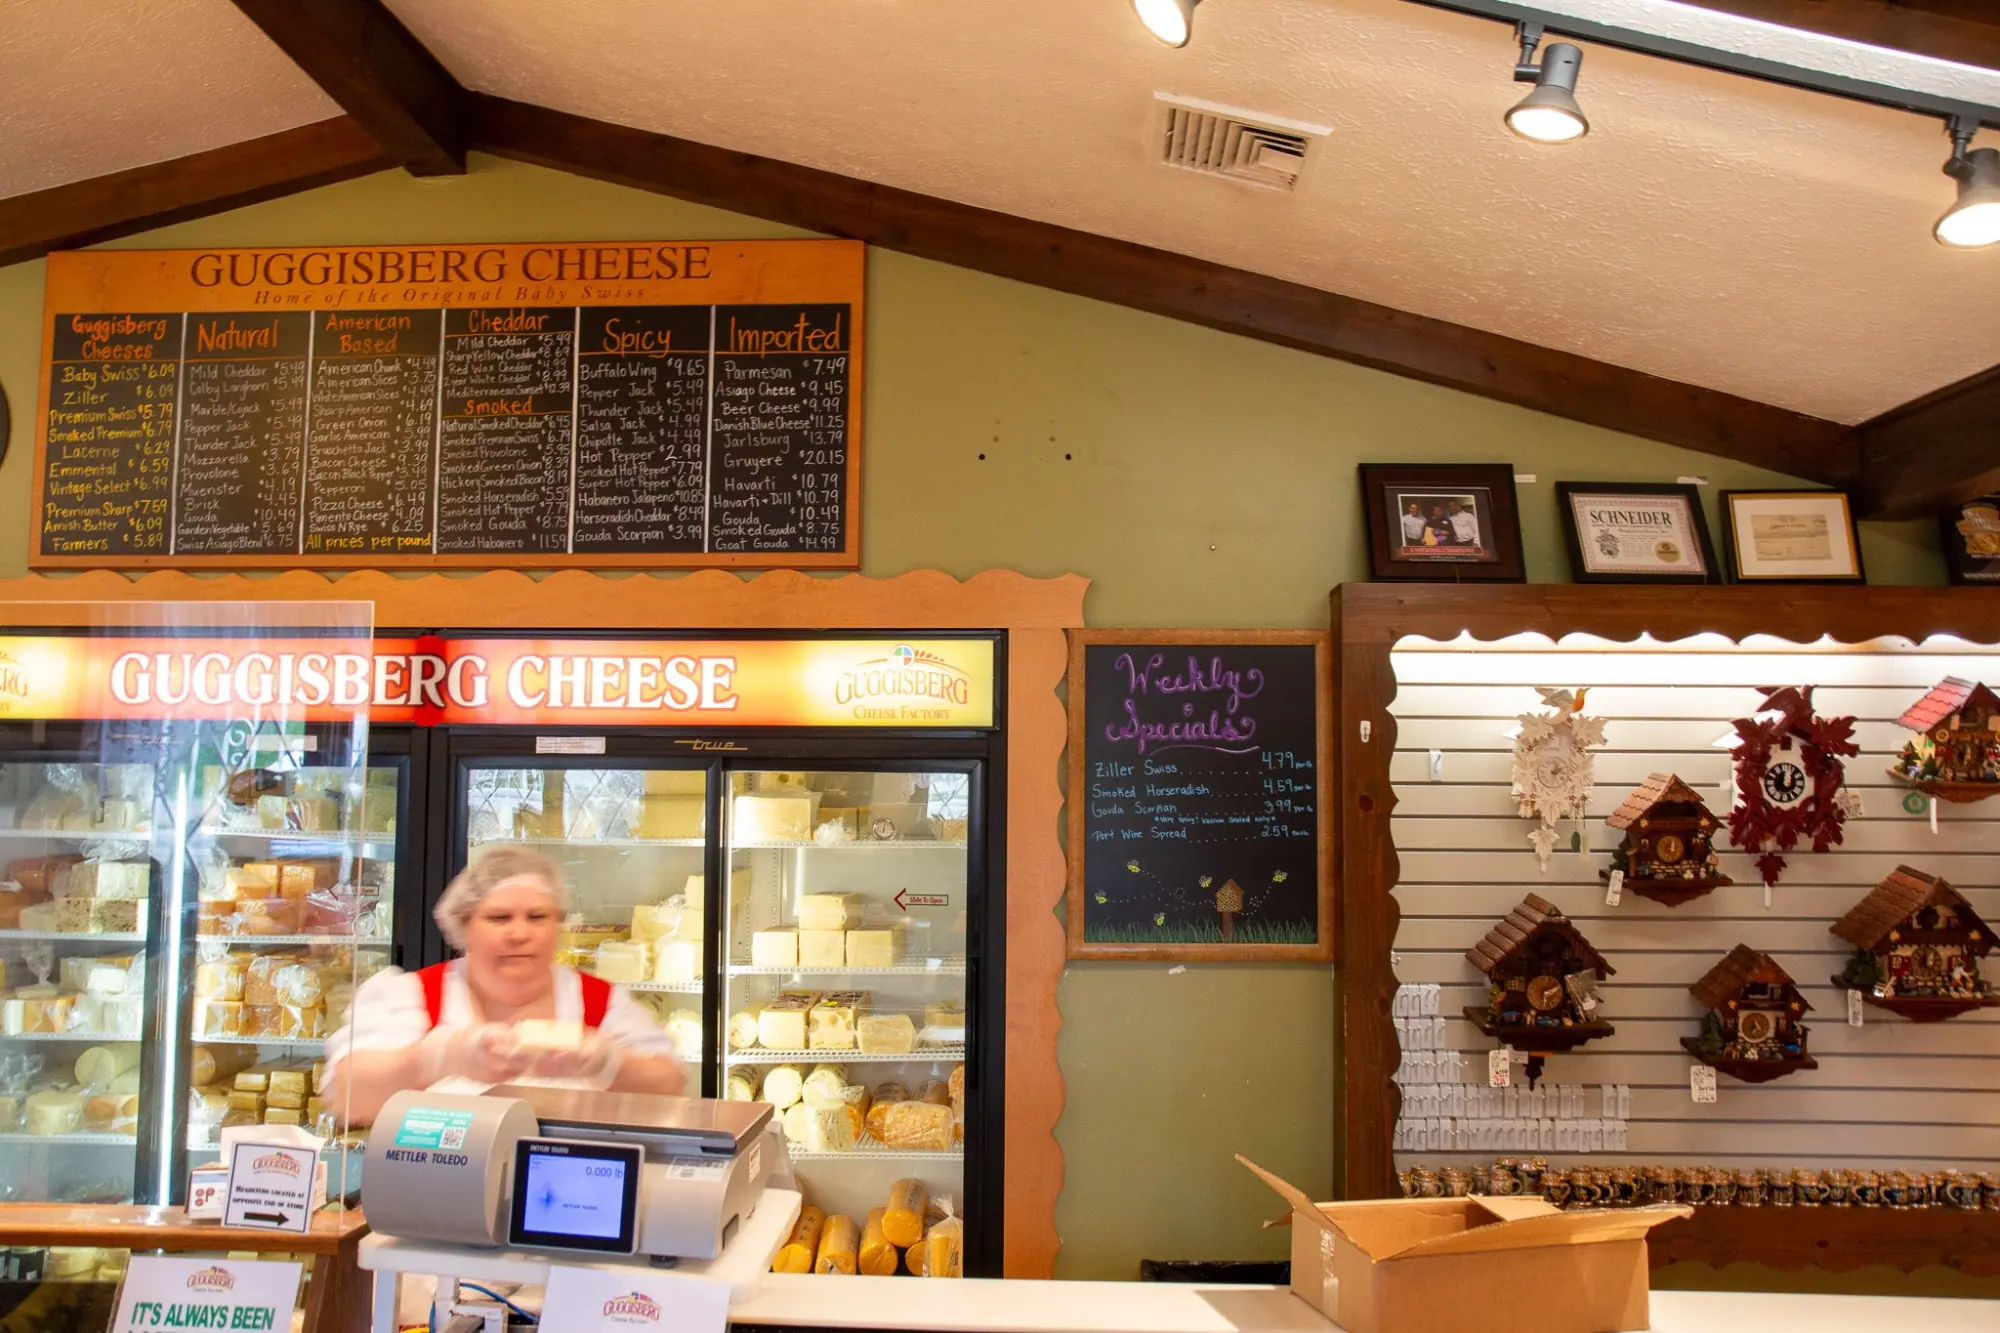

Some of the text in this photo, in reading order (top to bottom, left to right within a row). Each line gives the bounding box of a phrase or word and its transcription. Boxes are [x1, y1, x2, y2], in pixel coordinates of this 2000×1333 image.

[190, 246, 712, 288] GUGGISBERG CHEESE
[254, 285, 646, 309] Home of the Original Baby Swiss
[71, 314, 167, 342] Guggisberg
[325, 312, 411, 332] American
[468, 308, 550, 332] Cheddar
[198, 319, 279, 353] Natural
[339, 332, 398, 353] Based
[456, 335, 531, 350] Mild Cheddar
[603, 317, 671, 358] Spicy
[730, 312, 841, 358] Imported
[82, 340, 154, 359] Cheeses
[61, 364, 140, 390] Baby Swiss
[190, 364, 268, 379] Mild Cheddar
[579, 363, 627, 380] Buffalo
[627, 361, 657, 383] Wing
[724, 360, 792, 379] Parmesan
[62, 391, 108, 405] Ziller
[579, 384, 620, 401] Pepper
[628, 381, 656, 397] Jack
[715, 382, 755, 403] Asiago
[758, 381, 797, 396] Cheese
[464, 395, 533, 415] Smoked
[579, 403, 632, 417] Thunder
[638, 401, 664, 415] Jack
[721, 402, 754, 415] Beer
[758, 402, 800, 415] Cheese
[48, 409, 105, 426] Premium
[107, 406, 137, 421] Swiss
[316, 419, 355, 432] Green
[579, 417, 646, 432] Salsa Jack
[184, 435, 258, 451] Thunder Jack
[579, 431, 656, 450] Chipotle Jack
[724, 433, 790, 454] Jarlsburg
[183, 452, 250, 466] Mozzarella
[311, 456, 388, 469] Bacon Cheese
[580, 444, 701, 466] Hot Pepper $2.99
[724, 453, 783, 475] Gruyere
[49, 462, 117, 478] Emmental
[180, 467, 240, 481] Provolone
[49, 478, 131, 501] Vintage Select
[180, 483, 243, 498] Muenster
[312, 480, 366, 497] Pepperoni
[725, 476, 776, 491] Havarti
[184, 498, 221, 512] Brick
[311, 496, 384, 512] Pizza Cheese
[441, 492, 481, 504] Smoked
[45, 502, 101, 518] Premium
[102, 501, 133, 518] Sharp
[722, 511, 760, 525] Gouda
[1590, 510, 1672, 525] SCHNEIDER
[44, 518, 119, 534] Amish Butter
[441, 518, 483, 532] Smoked
[488, 517, 527, 530] Gouda
[712, 524, 797, 536] Smoked Gouda
[52, 537, 109, 551] Farmers
[305, 532, 432, 551] All prices per pound
[575, 529, 613, 543] Gouda
[617, 525, 664, 544] Scorpion
[715, 538, 789, 550] Goat Gouda
[111, 653, 738, 710] GUGGISBERG CHEESE
[835, 669, 969, 705] GUGGISBERG
[1114, 653, 1264, 714] Weekly
[1105, 700, 1256, 755] Specials
[692, 738, 735, 750] true
[1095, 762, 1134, 777] Ziller
[1144, 759, 1177, 775] Swiss
[1262, 751, 1294, 770] 4.79
[1092, 783, 1136, 798] Smoked
[1146, 783, 1209, 797] Horseradish
[1264, 779, 1293, 794] 4.59
[1121, 829, 1143, 840] Wine
[1150, 826, 1187, 840] Spread
[1261, 824, 1289, 838] 2.59
[385, 1150, 468, 1166] METTLER TOLEDO
[585, 1166, 612, 1177] 0.000
[131, 1302, 276, 1330] IT'S ALWAYS BEEN
